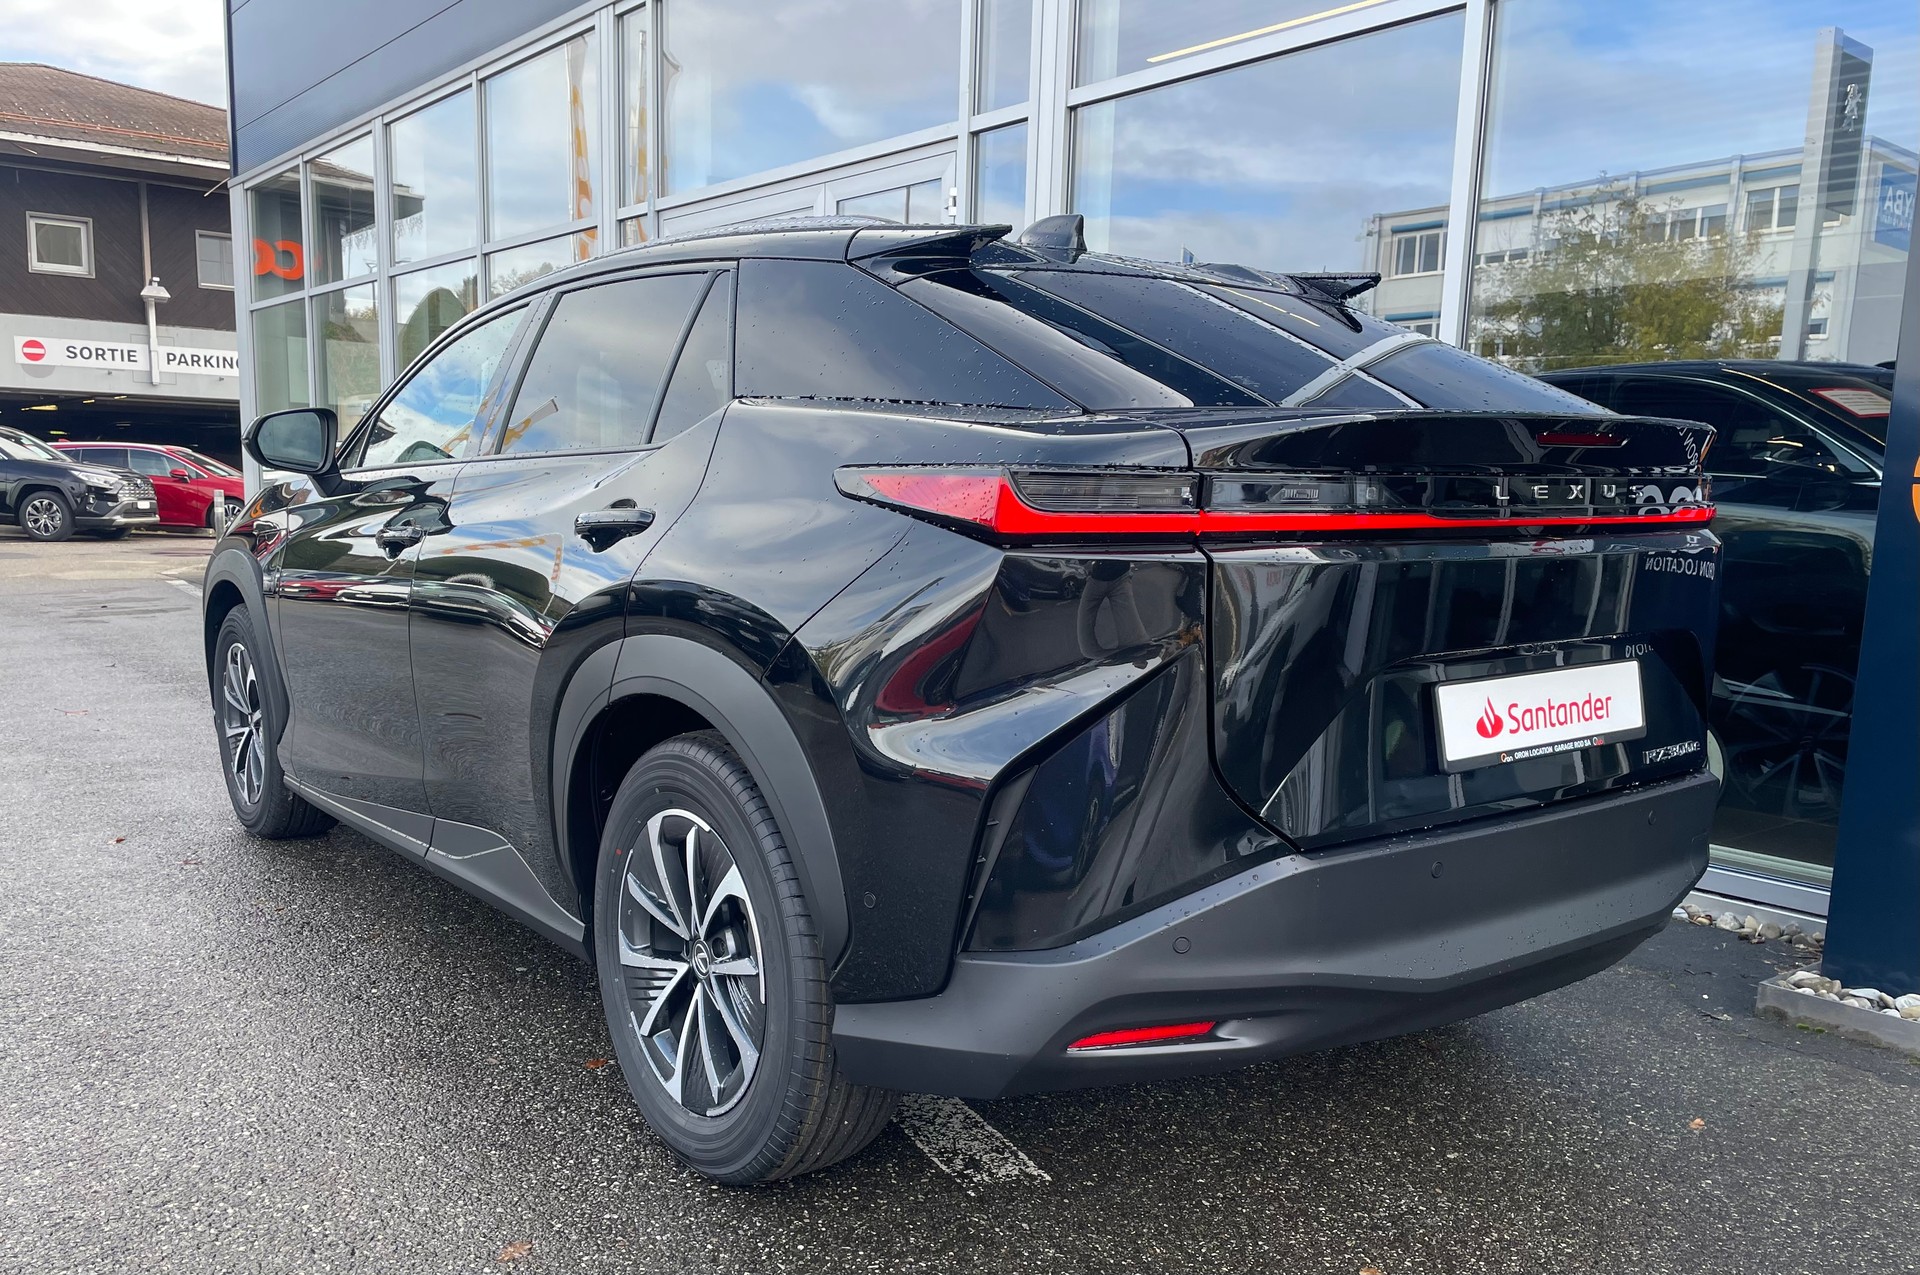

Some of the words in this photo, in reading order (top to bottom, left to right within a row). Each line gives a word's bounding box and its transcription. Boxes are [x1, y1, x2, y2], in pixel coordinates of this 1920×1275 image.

[66, 345, 138, 363] SORTIE
[166, 352, 240, 370] PARKIN
[1494, 484, 1644, 499] LEXUS
[1507, 693, 1612, 734] Santander
[1514, 750, 1529, 760] ORON
[1529, 745, 1553, 757] LOCATION
[1554, 741, 1574, 752] GARAGE
